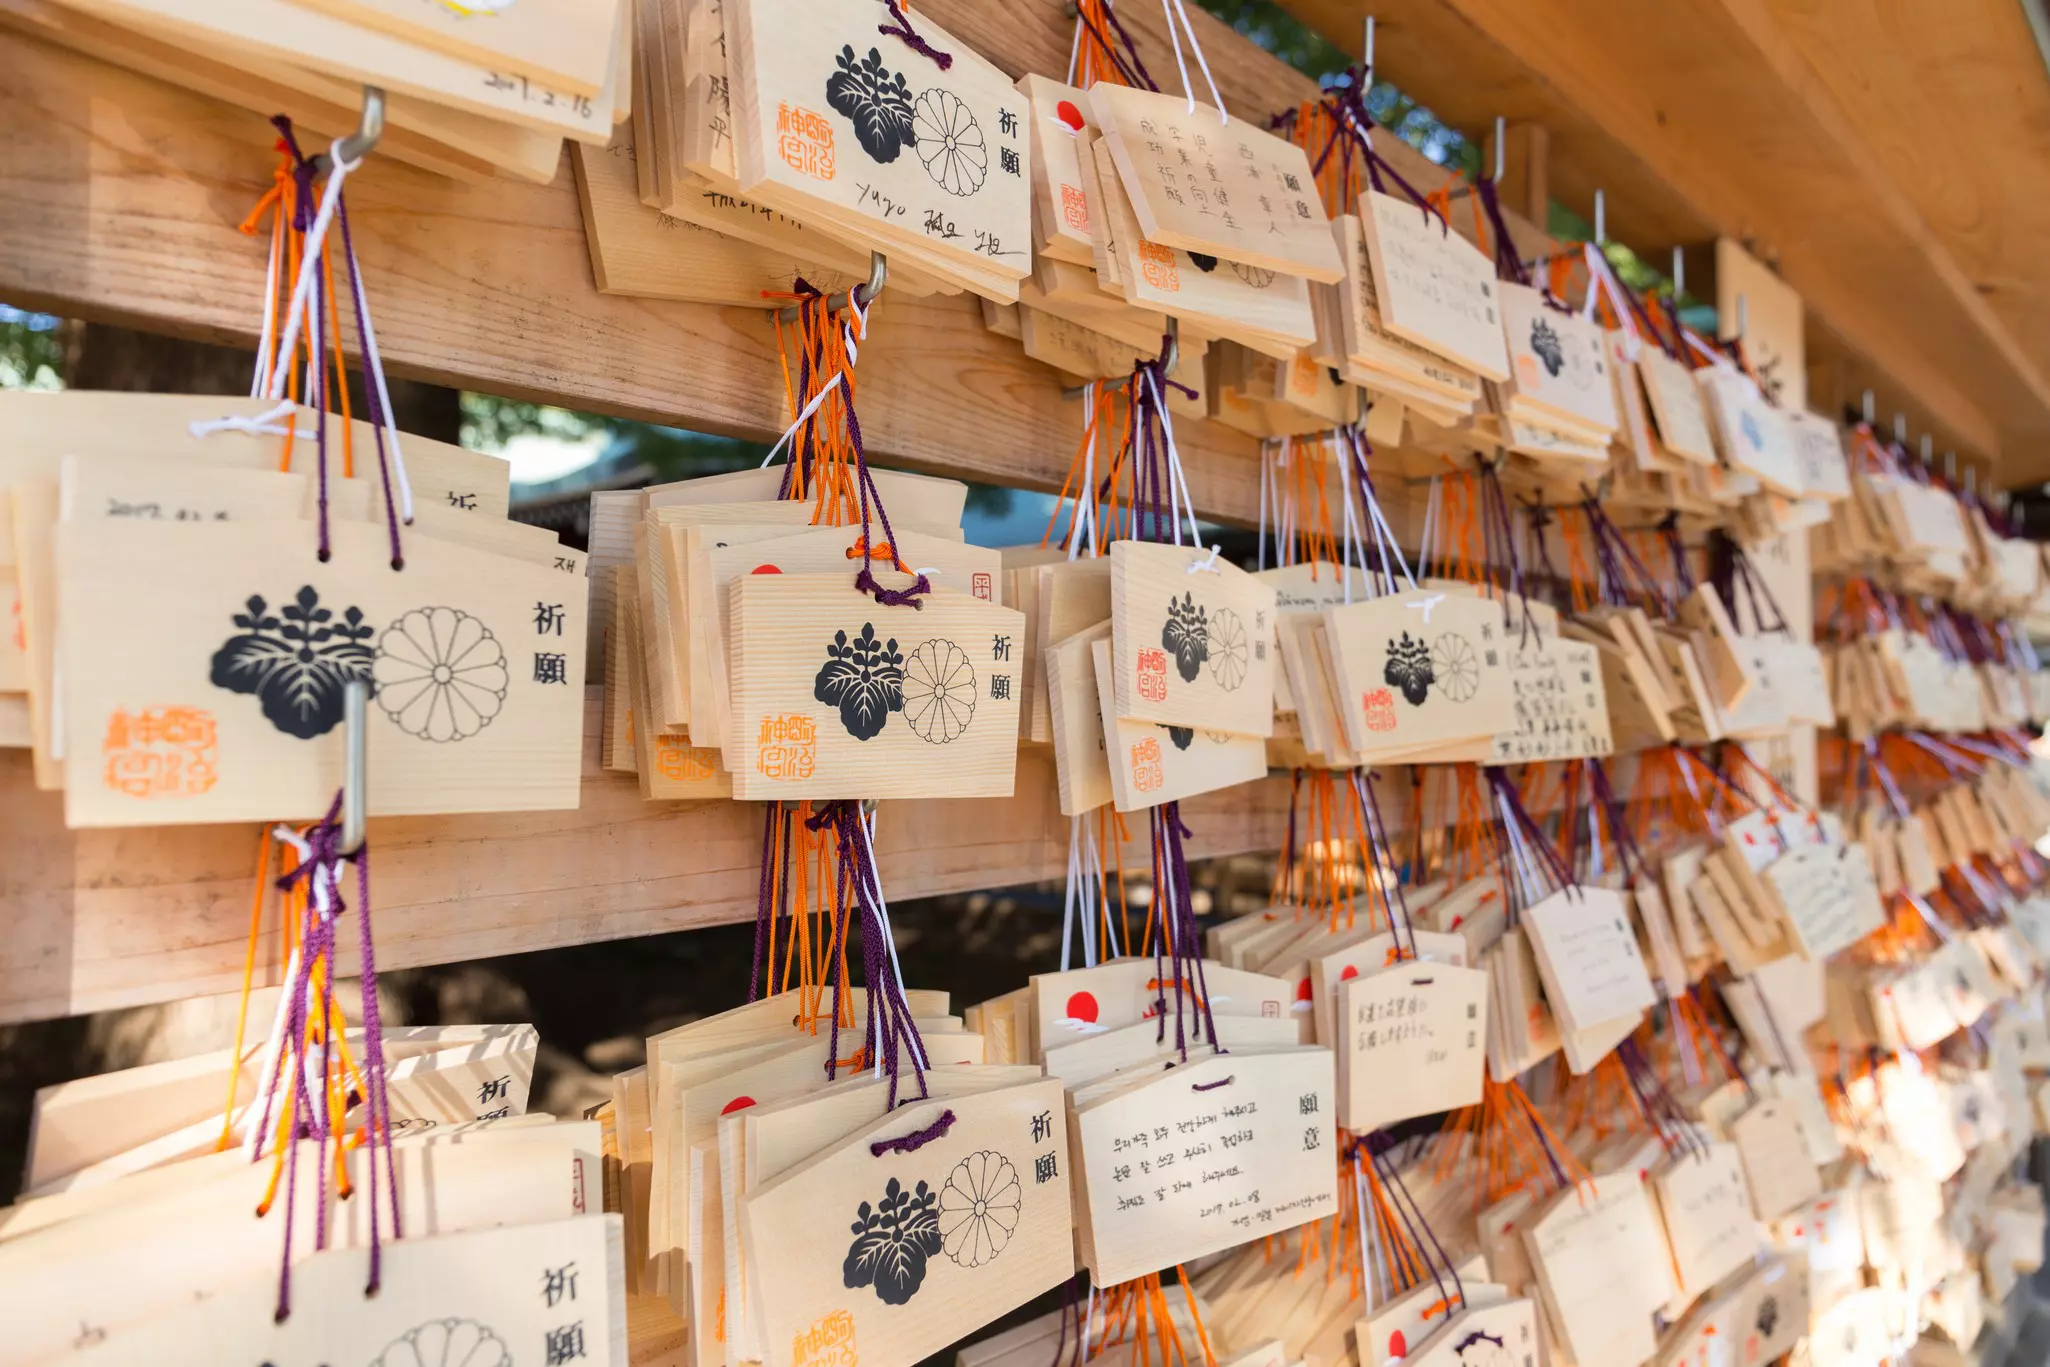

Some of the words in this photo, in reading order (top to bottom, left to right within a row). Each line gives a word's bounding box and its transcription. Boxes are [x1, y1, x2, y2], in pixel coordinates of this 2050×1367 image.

[998, 106, 1021, 178] 祈願
[532, 601, 568, 686] 祈願
[990, 634, 1012, 700] 祈願
[1030, 1109, 1058, 1184] 祈願
[1299, 1092, 1320, 1151] 願意
[539, 1260, 588, 1367] 祈願
